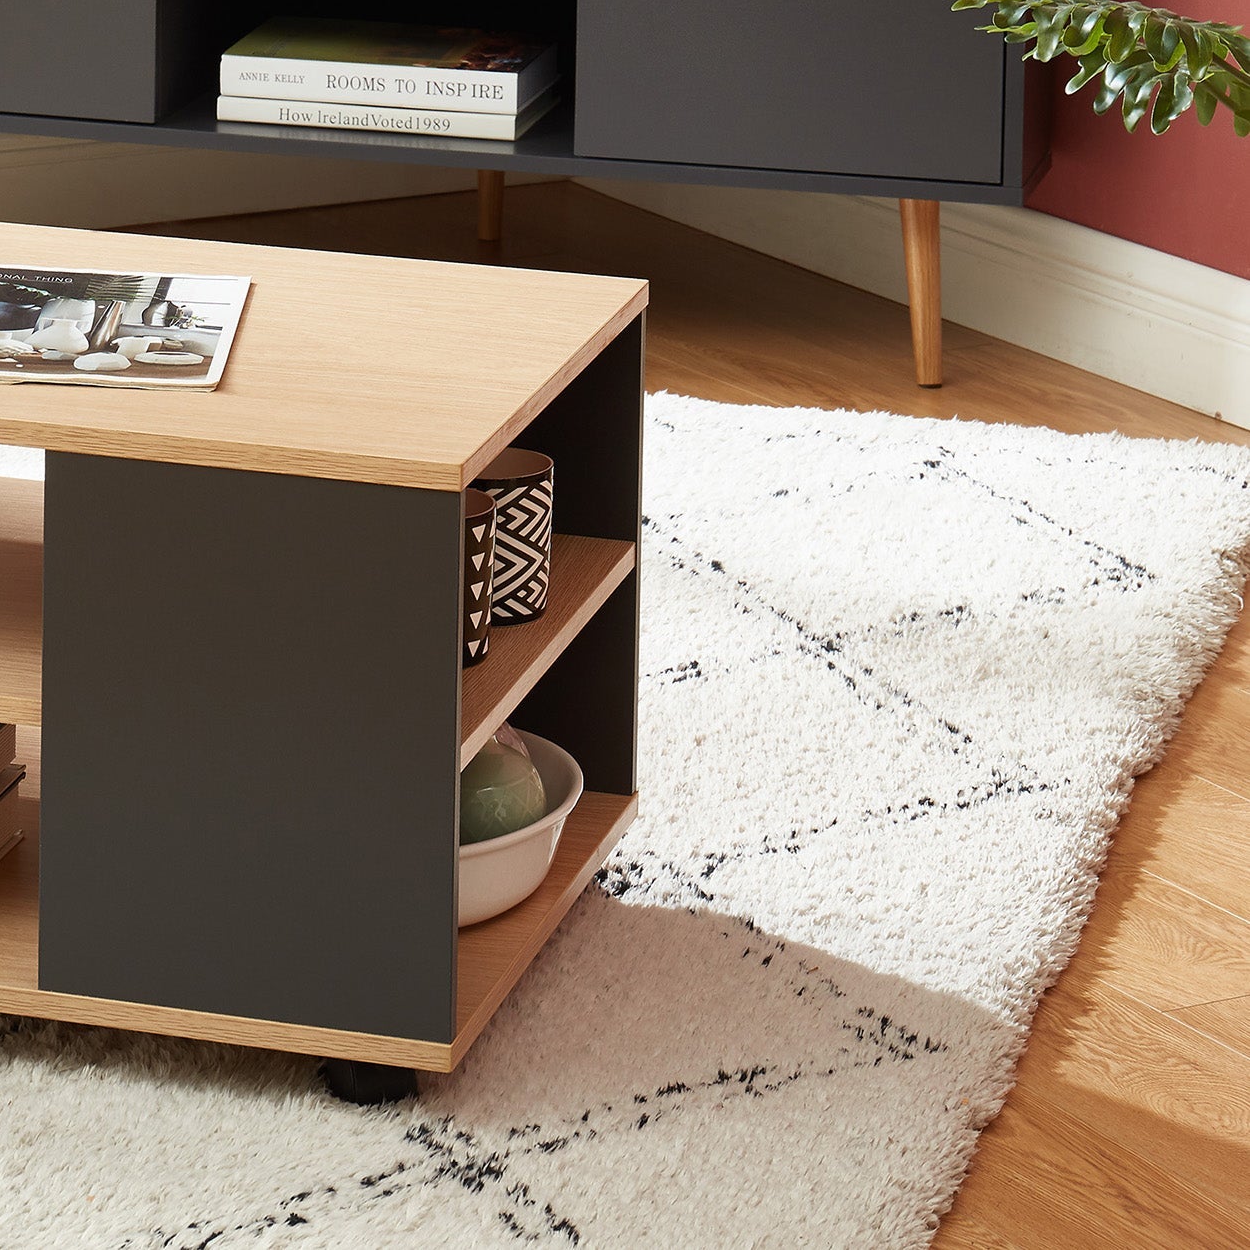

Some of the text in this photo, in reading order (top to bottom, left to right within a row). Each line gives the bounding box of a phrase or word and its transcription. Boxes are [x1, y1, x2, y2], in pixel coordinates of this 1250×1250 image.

[239, 72, 504, 100] ANNIE KELLY ROOMS TO INSPIRE
[279, 108, 313, 122] How
[35, 275, 73, 283] THING
